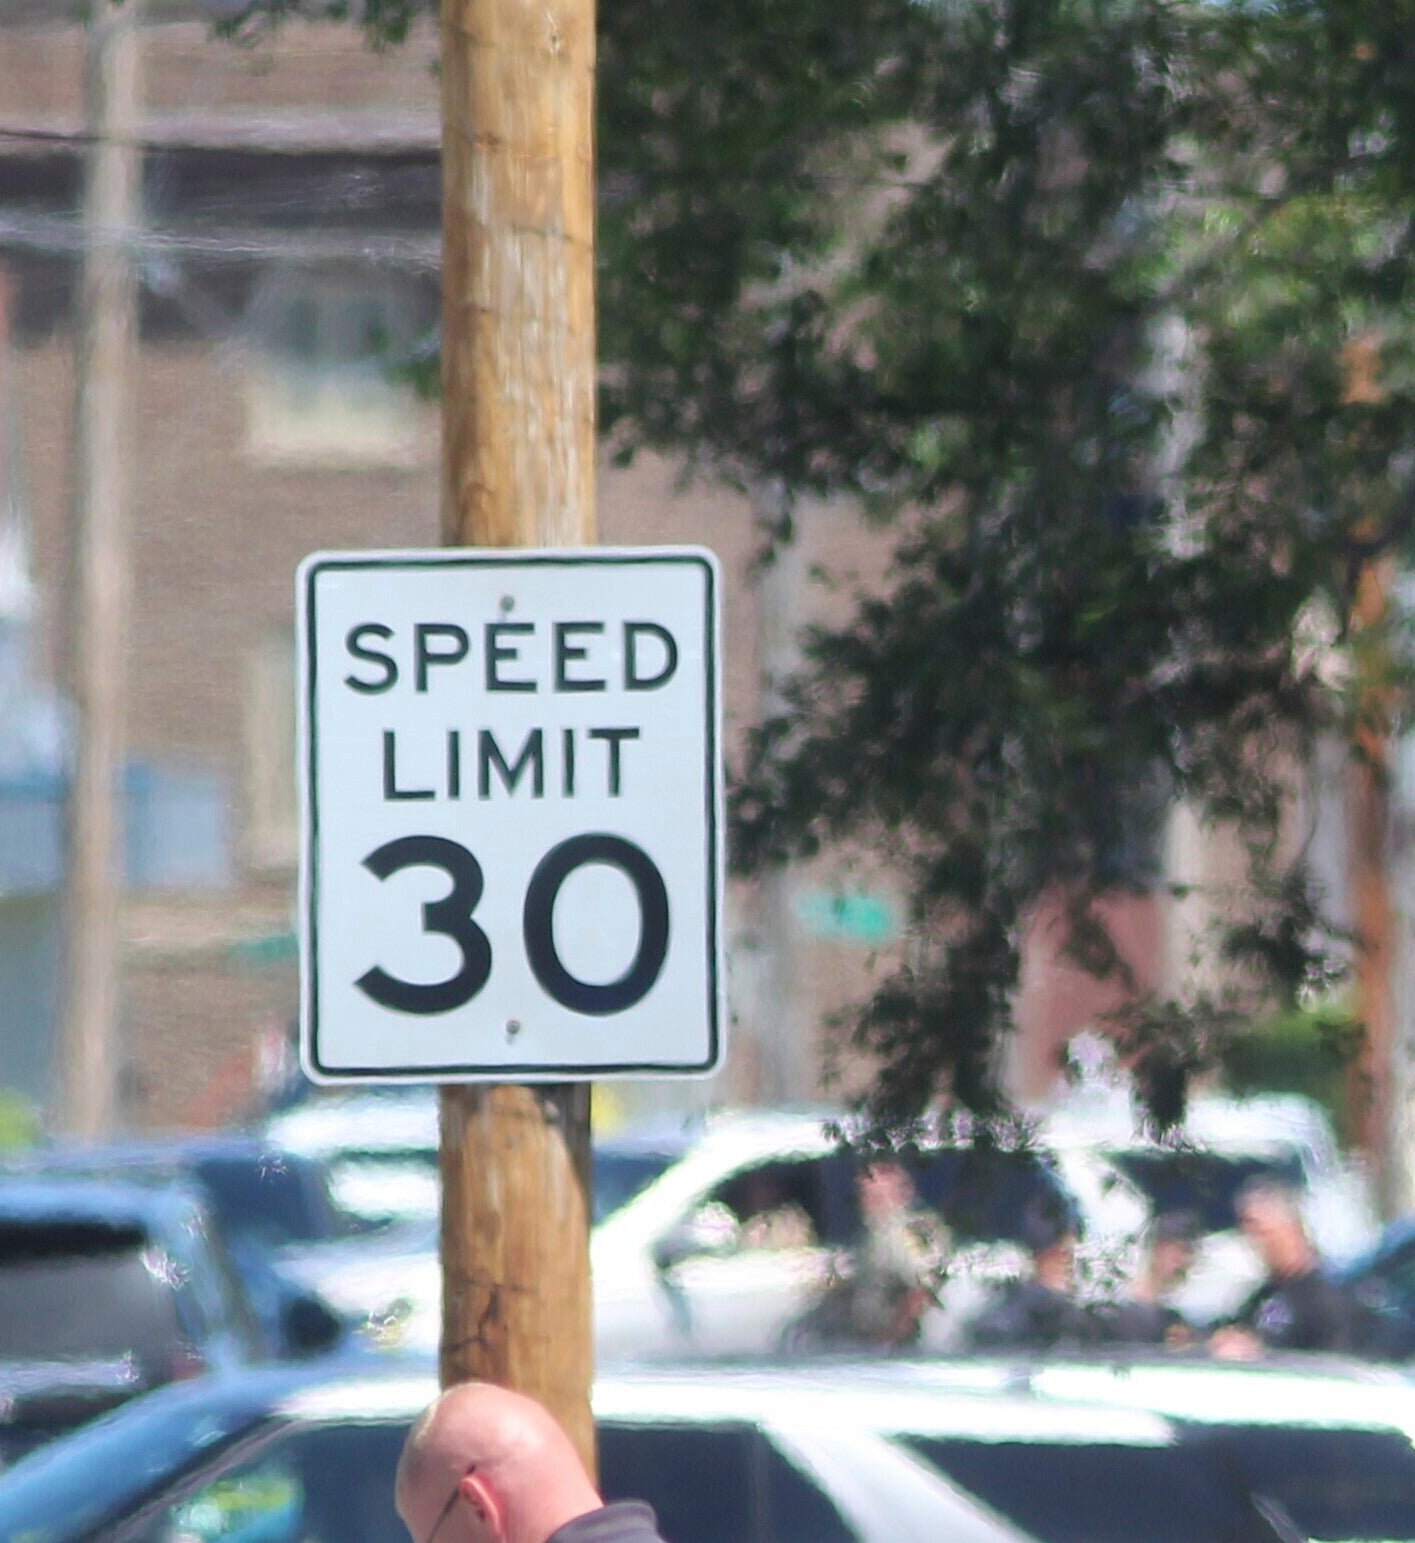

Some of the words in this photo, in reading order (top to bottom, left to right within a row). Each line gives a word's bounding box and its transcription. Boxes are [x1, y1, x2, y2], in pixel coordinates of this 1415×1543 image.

[343, 620, 679, 695] SPEED
[382, 726, 641, 801] LIMIT
[353, 830, 671, 1018] 30
